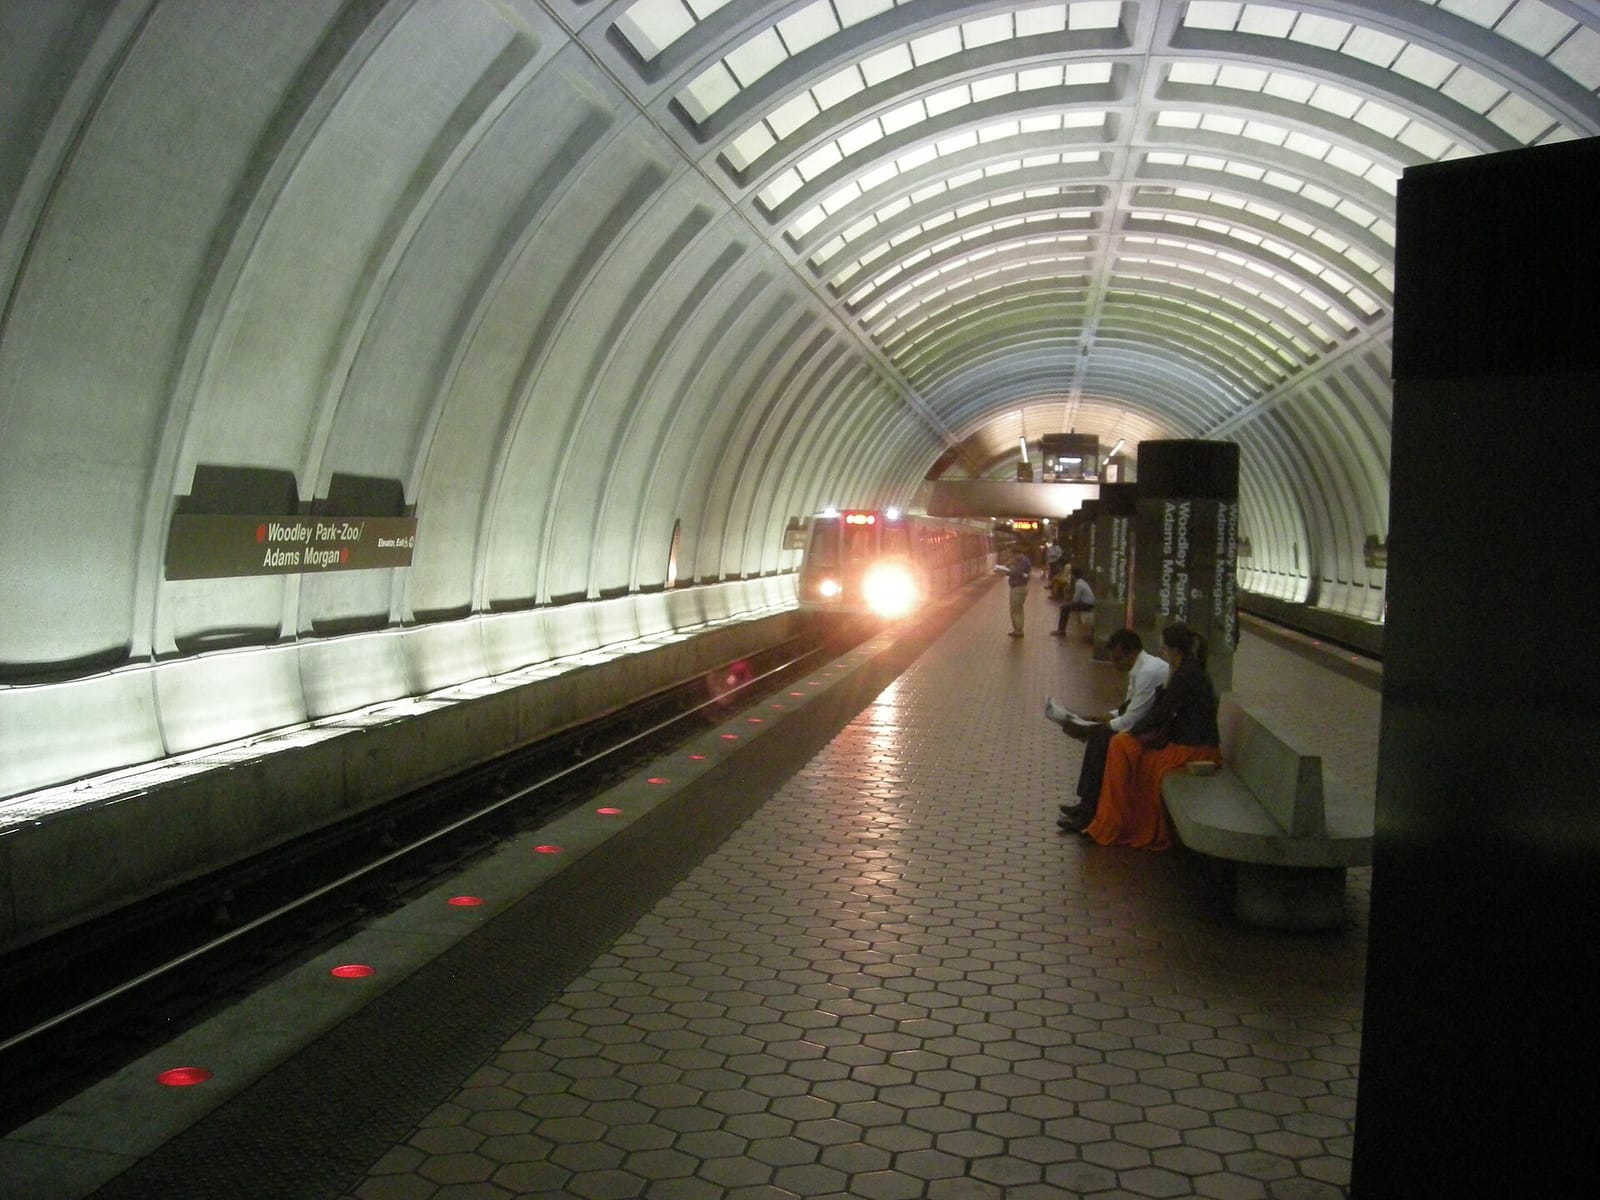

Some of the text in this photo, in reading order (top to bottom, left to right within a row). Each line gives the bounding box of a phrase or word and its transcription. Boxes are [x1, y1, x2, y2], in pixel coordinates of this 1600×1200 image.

[263, 546, 340, 568] Adams Morgan
[268, 522, 364, 544] Woodley Park-Zoo/
[1159, 502, 1175, 616] Adams Morgan
[1175, 502, 1191, 624] Woodley Park-Z
[1213, 502, 1227, 616] Adams Morgan
[1226, 503, 1238, 568] Woodley
